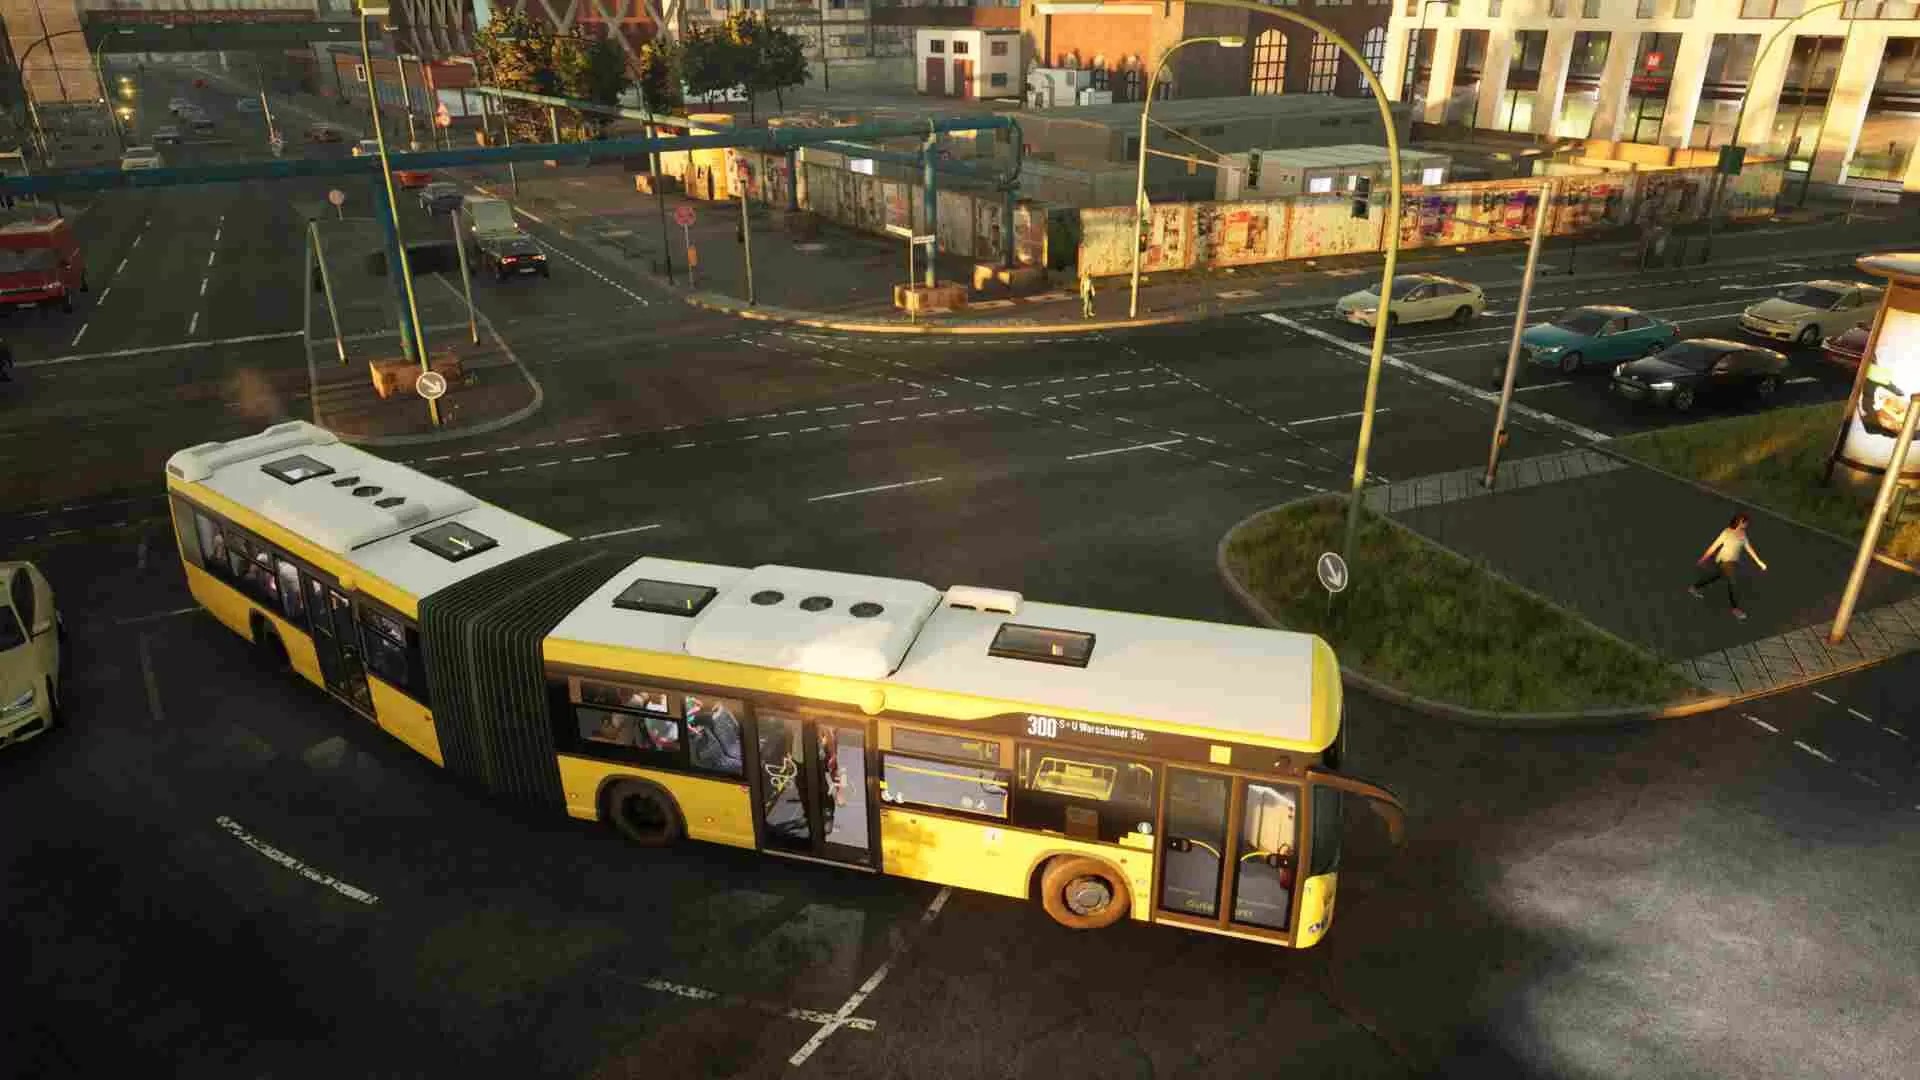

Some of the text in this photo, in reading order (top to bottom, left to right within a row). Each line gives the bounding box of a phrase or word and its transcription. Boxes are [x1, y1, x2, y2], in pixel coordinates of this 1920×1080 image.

[1027, 715, 1057, 738] 300
[1079, 722, 1128, 738] Warschauer
[1130, 729, 1147, 741] Str.
